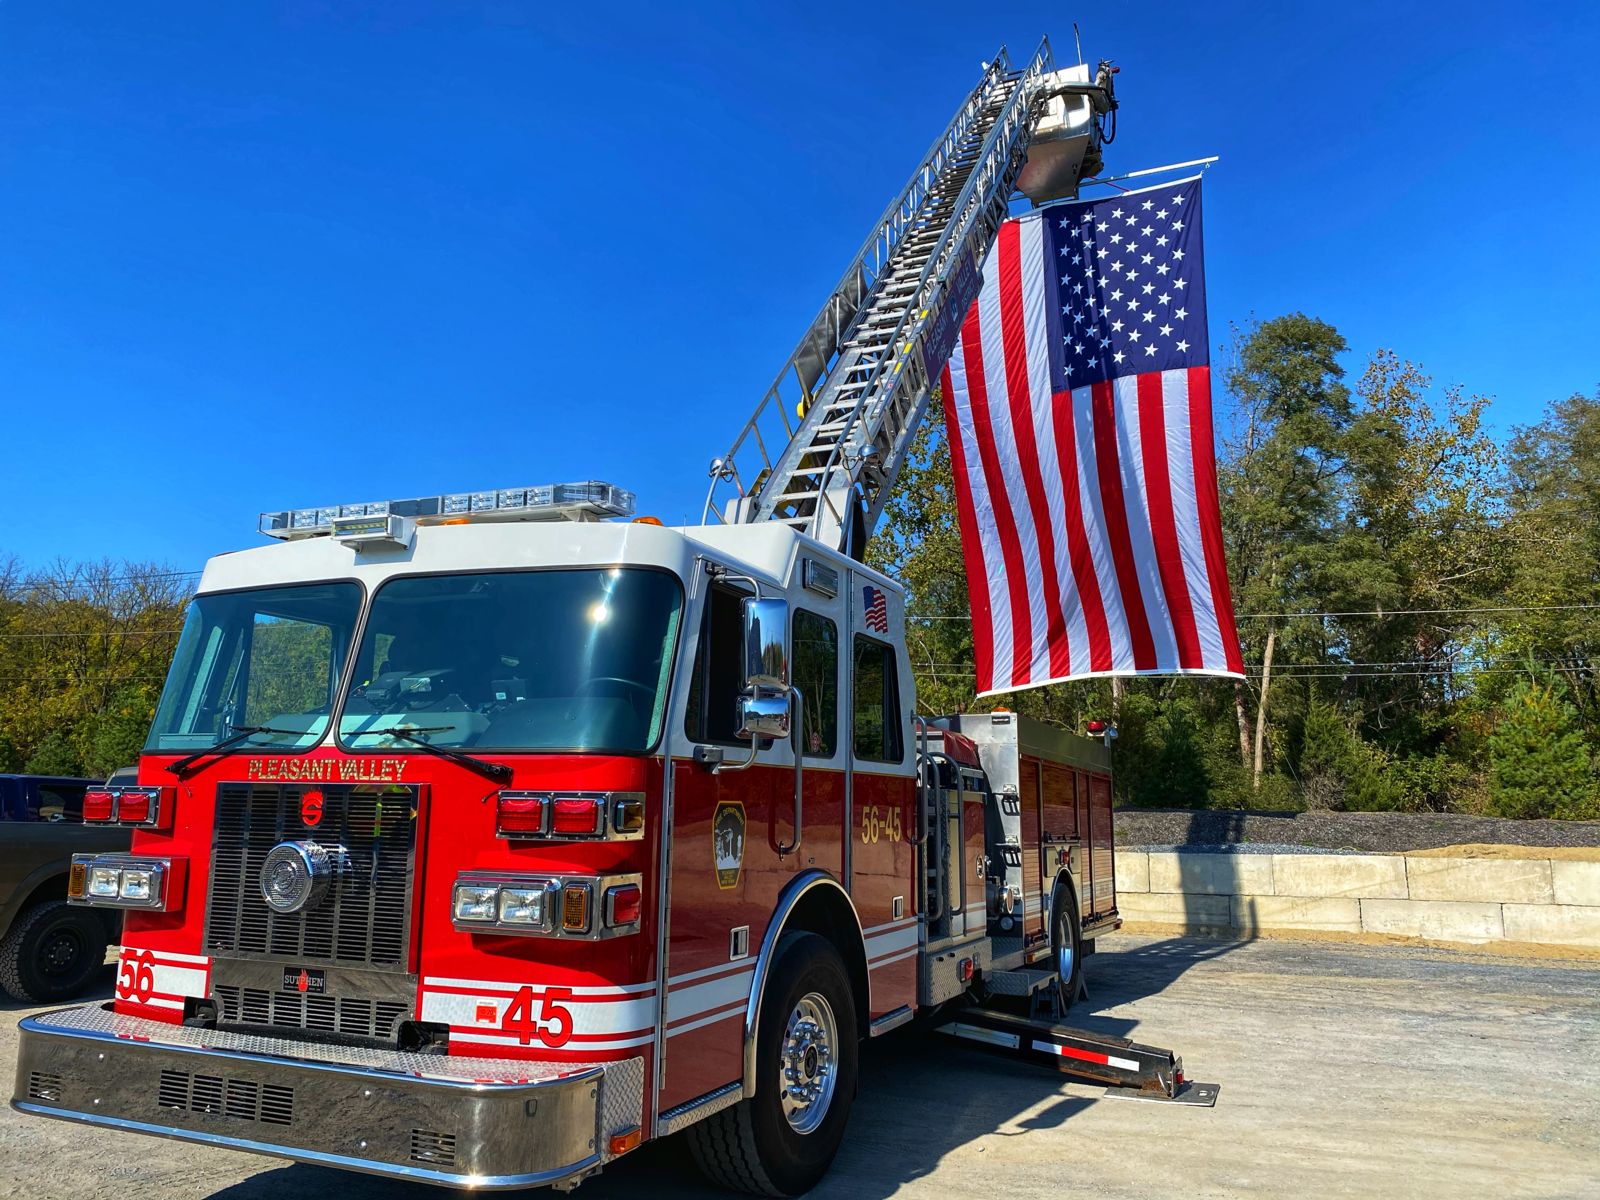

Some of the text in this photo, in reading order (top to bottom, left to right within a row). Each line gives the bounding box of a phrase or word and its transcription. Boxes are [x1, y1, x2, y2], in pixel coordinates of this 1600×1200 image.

[248, 759, 407, 781] PLEASANT VALLEY
[861, 806, 902, 845] 56-45
[118, 949, 155, 1004] 56
[284, 975, 324, 987] SUTPHEN
[501, 985, 574, 1048] 45
